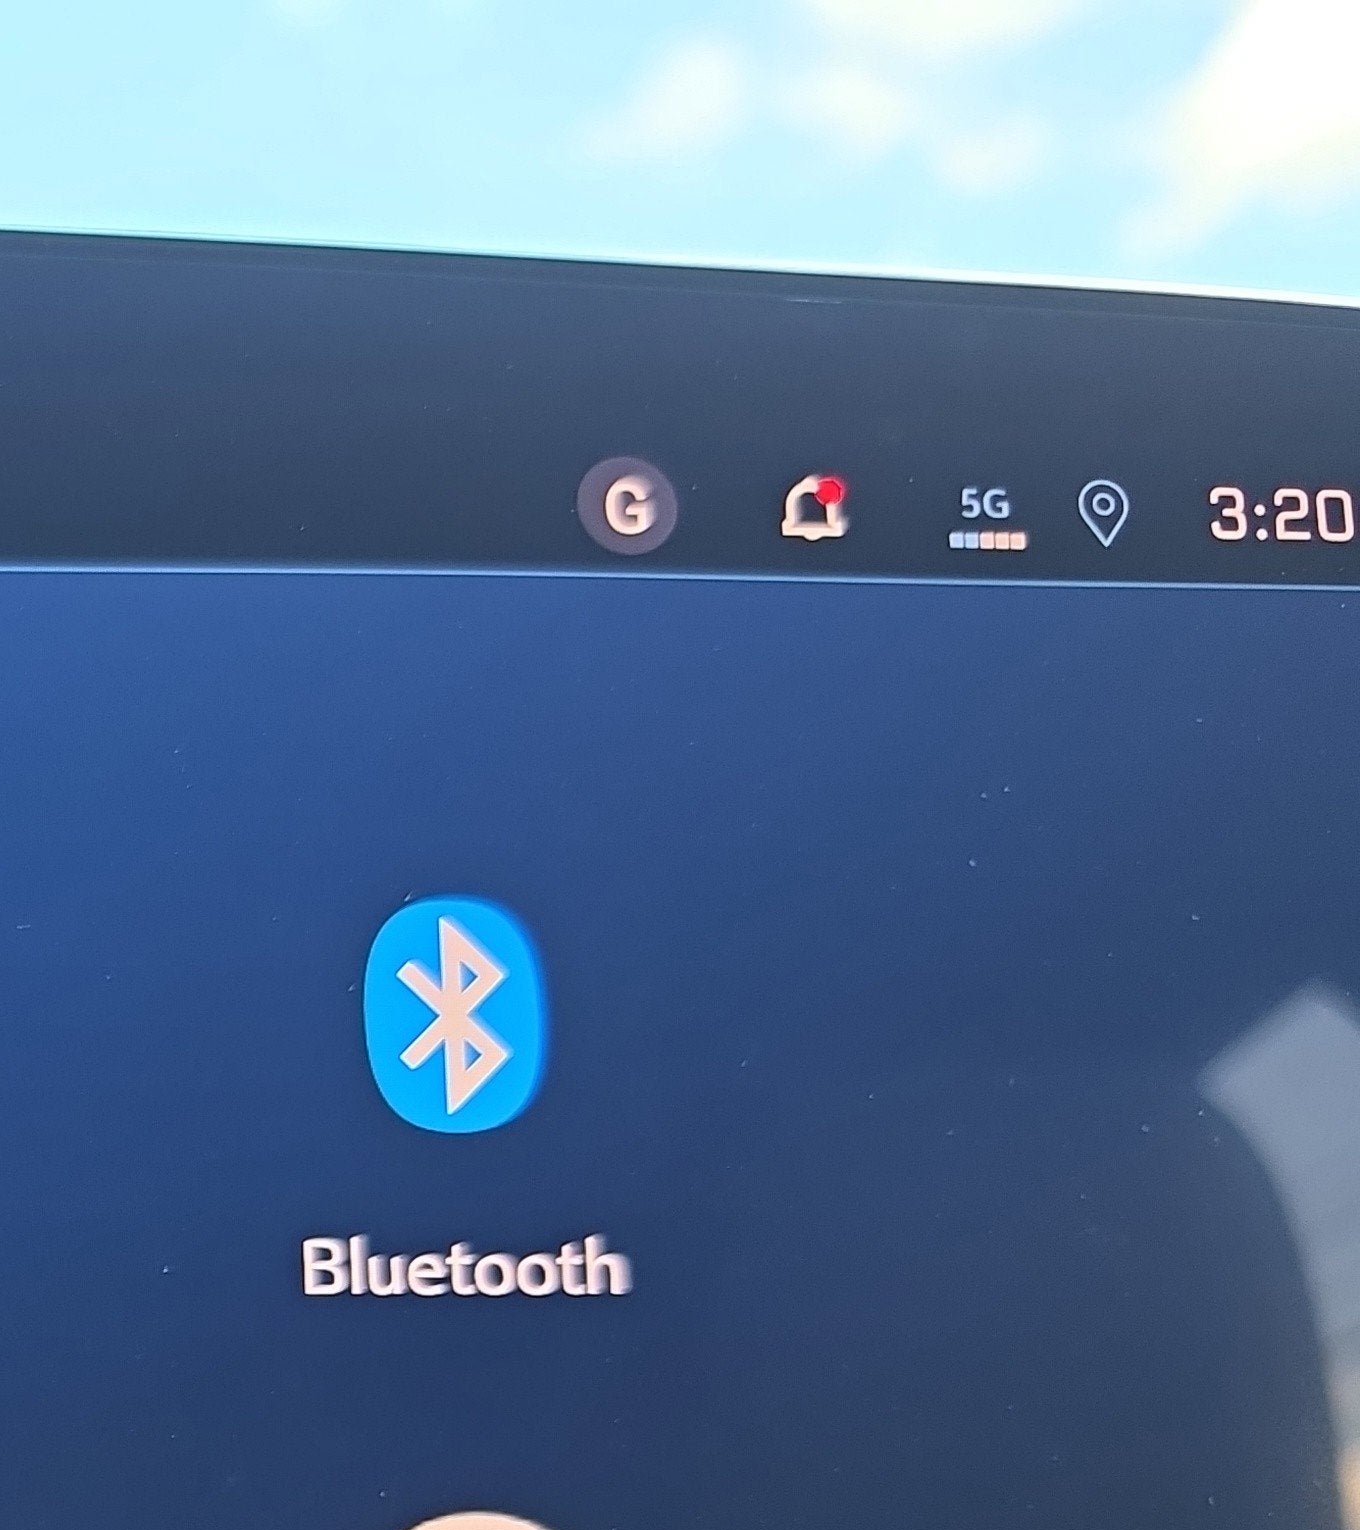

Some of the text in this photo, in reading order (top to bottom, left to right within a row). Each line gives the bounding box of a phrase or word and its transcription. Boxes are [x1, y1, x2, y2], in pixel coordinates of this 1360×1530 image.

[960, 488, 1012, 520] 5G
[1208, 486, 1355, 542] 3:20
[301, 1234, 632, 1298] Bluetooth
